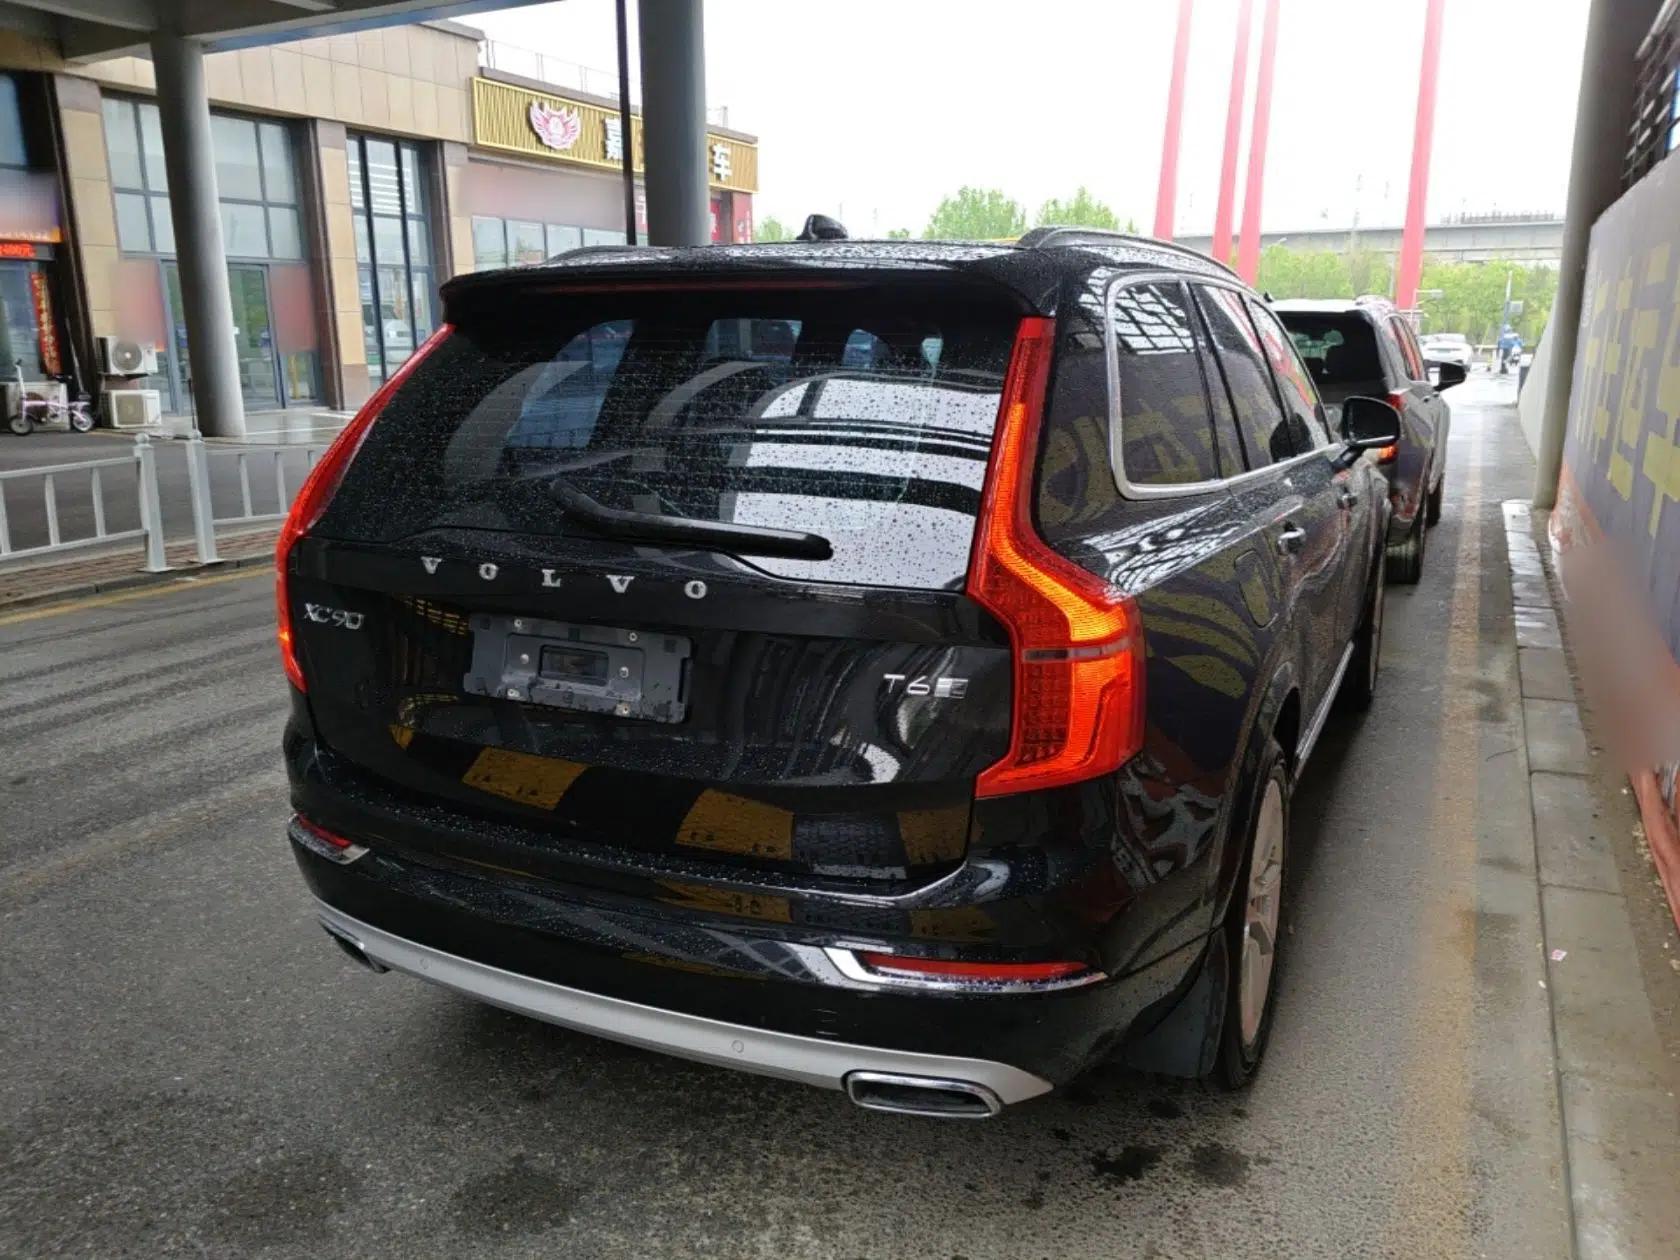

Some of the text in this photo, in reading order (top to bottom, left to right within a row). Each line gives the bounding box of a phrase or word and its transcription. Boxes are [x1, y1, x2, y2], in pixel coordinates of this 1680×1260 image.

[420, 556, 708, 599] VOLVO
[304, 603, 364, 630] XC90
[883, 673, 930, 695] T6
